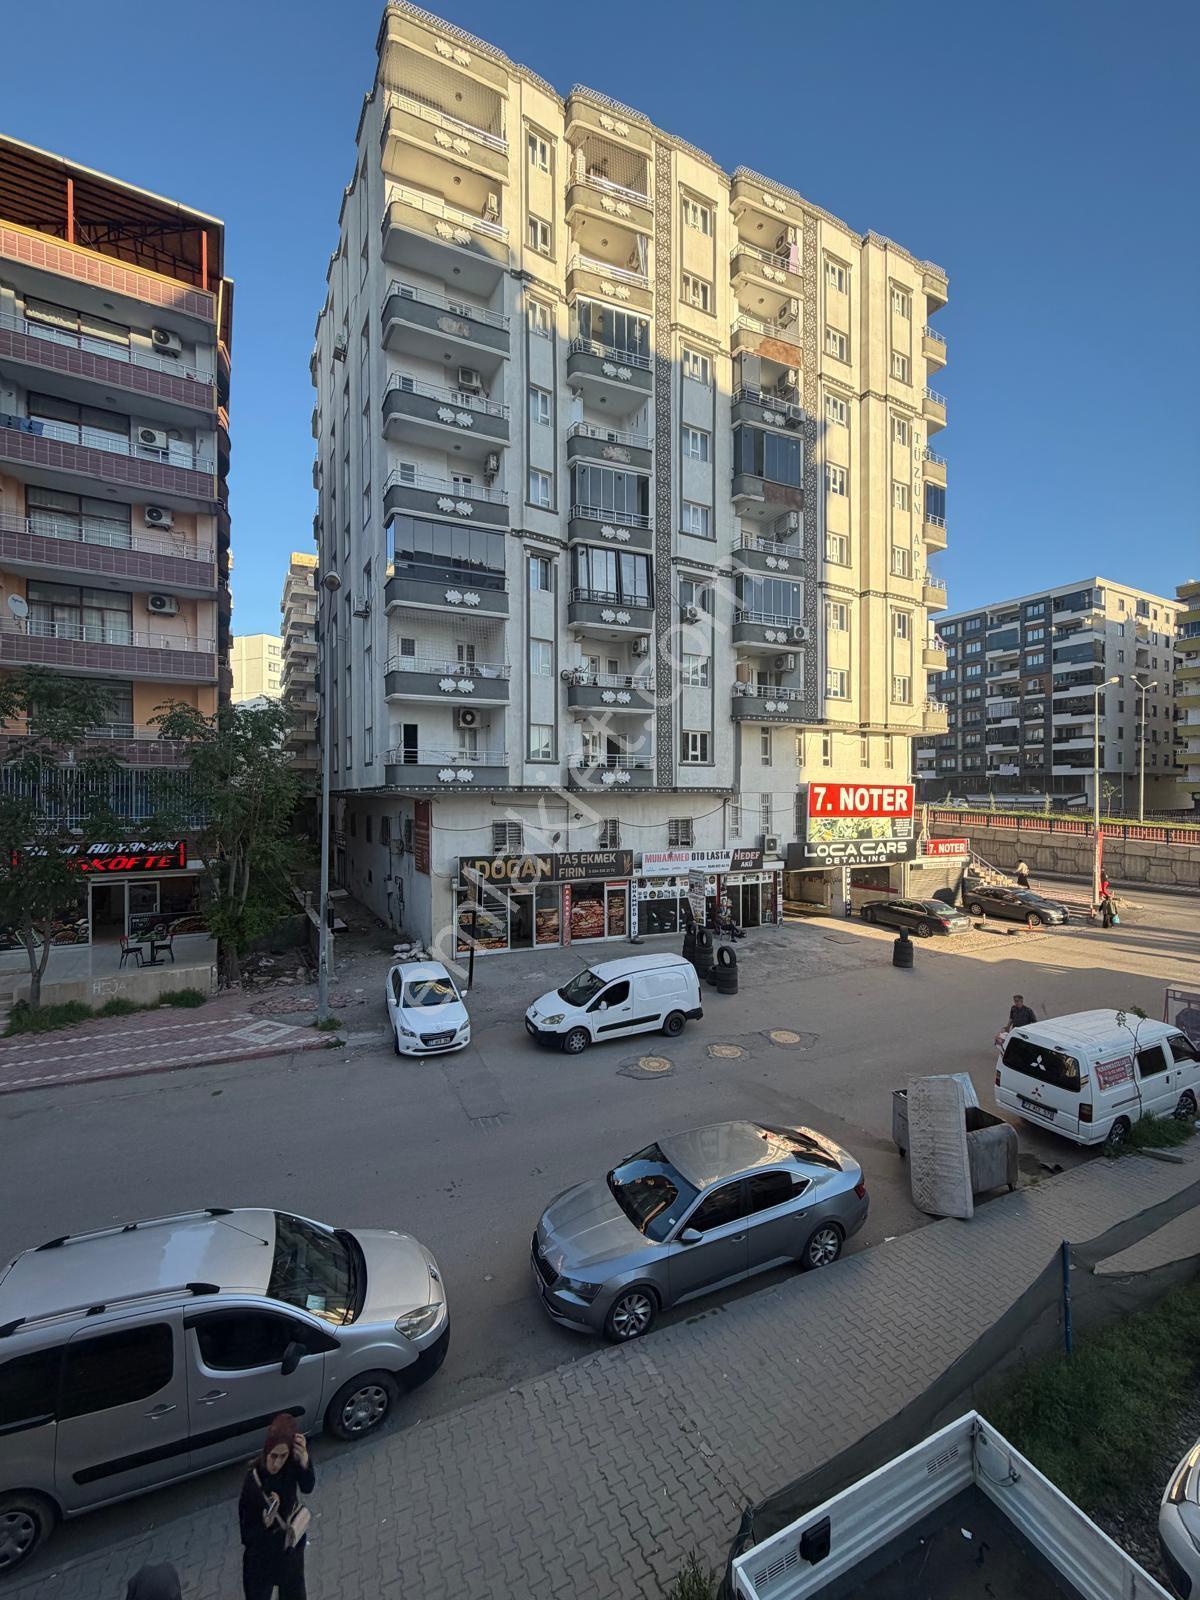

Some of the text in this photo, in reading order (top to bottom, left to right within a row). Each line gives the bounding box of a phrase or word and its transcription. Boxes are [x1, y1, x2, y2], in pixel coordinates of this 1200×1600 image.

[813, 786, 908, 812] 7. NOTER
[804, 841, 908, 858] LOCA CARS
[928, 842, 966, 854] 7. NOTER
[558, 852, 617, 866] TAŞ EKMEK
[644, 853, 690, 863] MUHAMMED
[691, 851, 705, 861] OTO
[734, 850, 761, 860] HEDEF
[825, 855, 887, 865] DETAILING
[474, 854, 552, 880] DOĞAN
[740, 860, 753, 868] AKÜ
[558, 866, 586, 879] FIRIN
